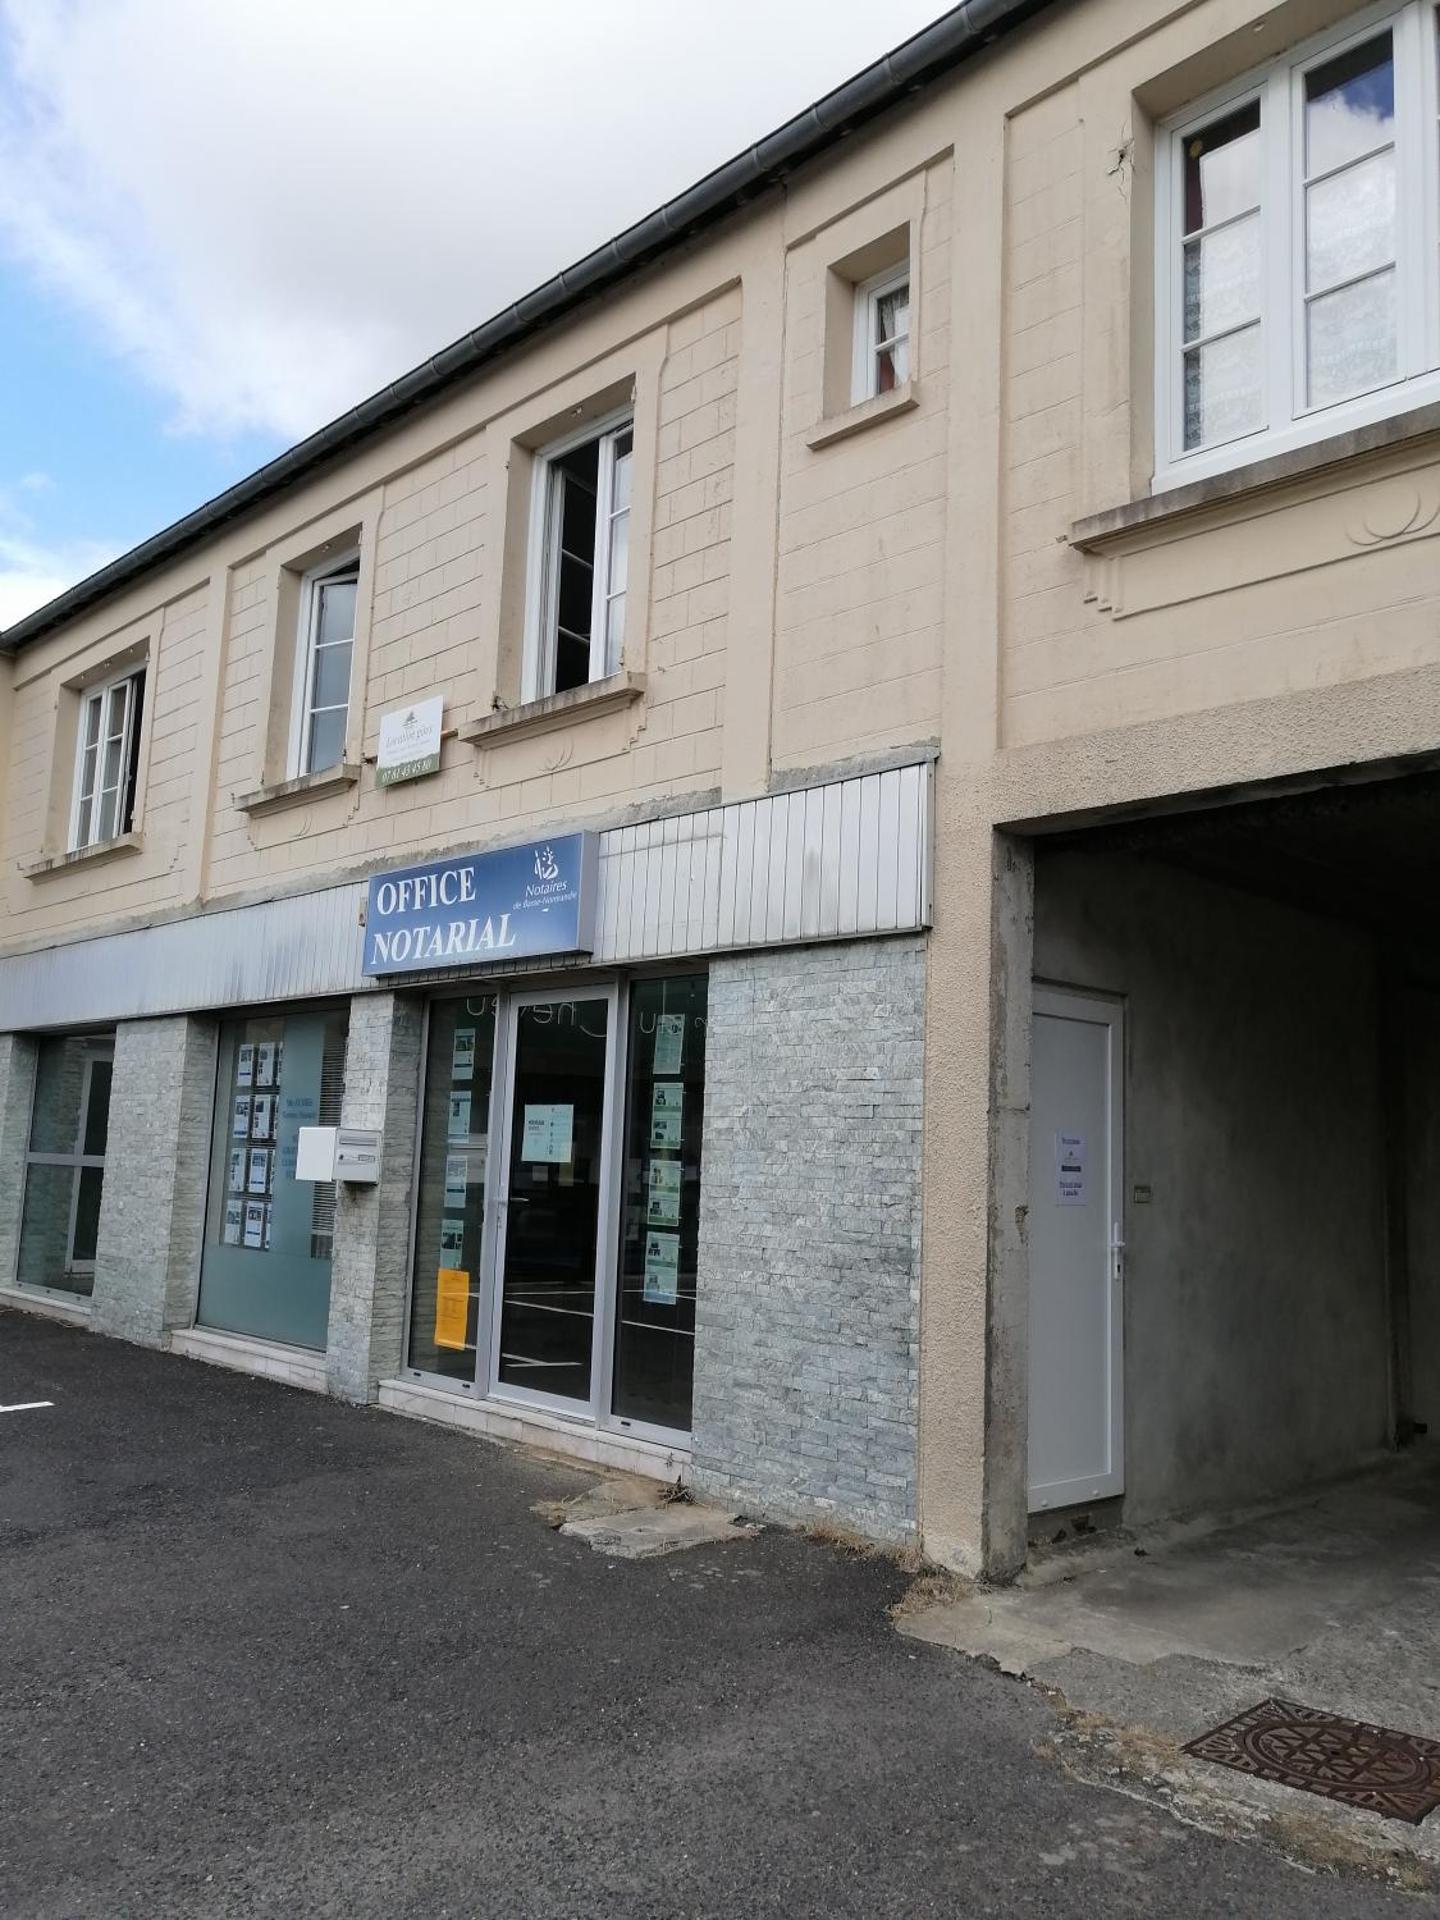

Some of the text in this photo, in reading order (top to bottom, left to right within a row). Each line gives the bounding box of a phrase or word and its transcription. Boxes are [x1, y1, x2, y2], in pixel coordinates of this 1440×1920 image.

[377, 867, 477, 915] OFFICE
[525, 881, 568, 897] Notaires
[370, 913, 516, 965] NOTARIAL
